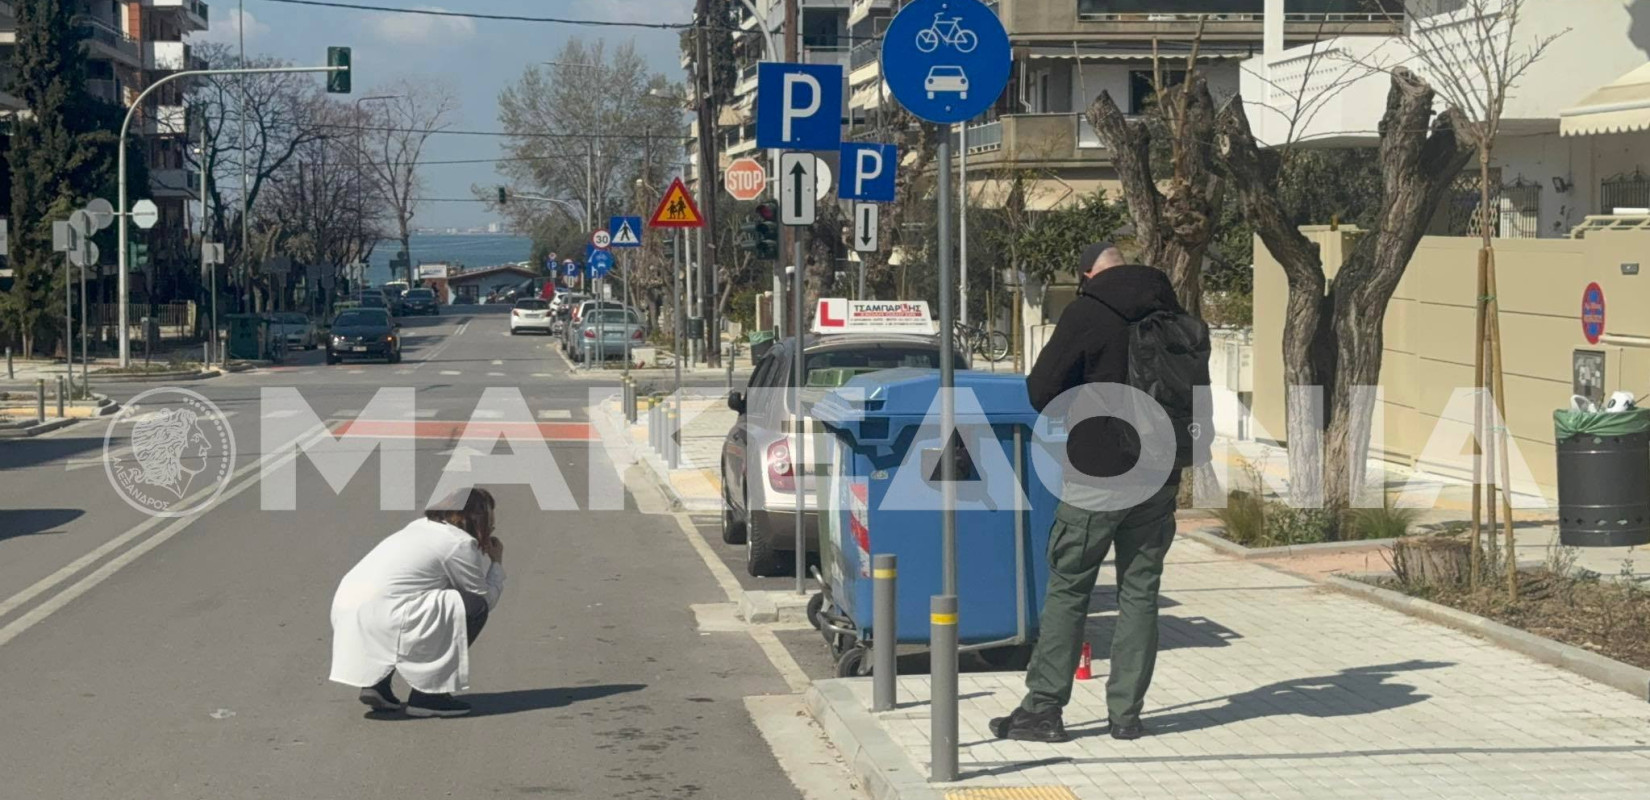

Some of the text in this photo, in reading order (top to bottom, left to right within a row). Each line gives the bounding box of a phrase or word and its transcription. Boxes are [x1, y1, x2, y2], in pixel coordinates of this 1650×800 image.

[782, 73, 821, 142] P
[728, 172, 762, 191] STOP
[856, 149, 883, 196] P
[596, 235, 609, 244] 30
[567, 263, 575, 275] P
[820, 302, 844, 326] L
